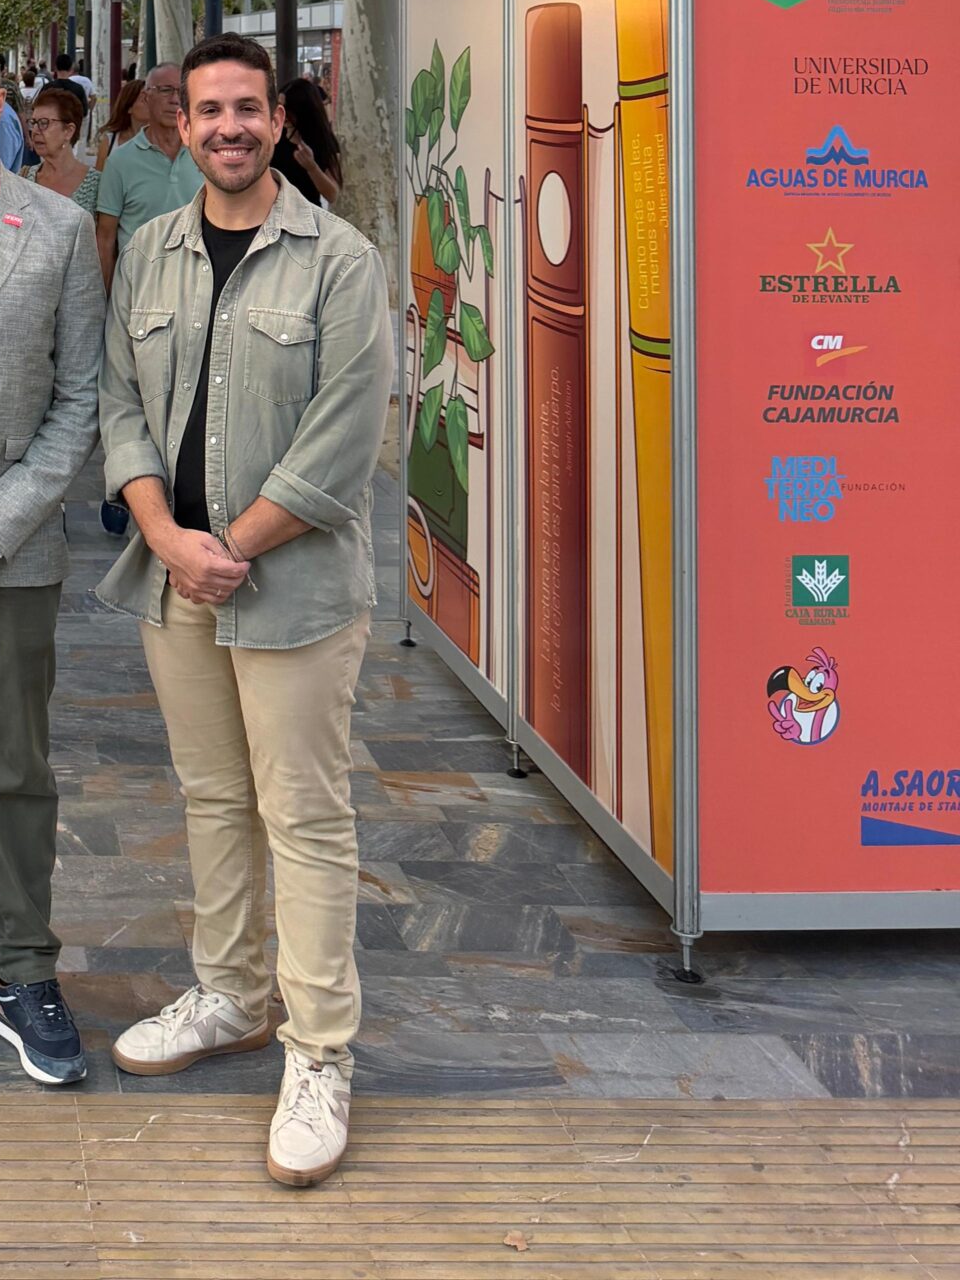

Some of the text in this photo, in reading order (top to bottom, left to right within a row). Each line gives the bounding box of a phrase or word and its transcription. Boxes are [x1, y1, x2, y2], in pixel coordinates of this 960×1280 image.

[794, 57, 929, 76] UNIVERSIDAD
[794, 77, 908, 96] DE MURCIA
[654, 133, 667, 185] Renard
[746, 168, 929, 189] AGUAS DE MURCIA
[658, 188, 669, 228] Jules
[629, 133, 650, 309] Cuanto más se lee.
[642, 146, 661, 294] menos se imita
[759, 275, 902, 294] ESTRELLA
[792, 294, 870, 304] DE LEVANTE
[811, 334, 843, 350] CM
[767, 381, 895, 402] FUNDACIÓN
[762, 406, 900, 424] CAJAMURCIA
[549, 440, 560, 459] el
[539, 469, 550, 488] la
[551, 463, 562, 511] para
[841, 482, 906, 492] FUNDACIÓN
[540, 490, 552, 537] para
[778, 500, 836, 522] NEO
[551, 513, 561, 537] es
[541, 540, 551, 564] es
[551, 541, 563, 627] ejercicio
[540, 568, 551, 636] lectura
[784, 608, 850, 618] CAJA RURAL
[550, 628, 561, 648] el
[540, 639, 551, 663] La
[551, 651, 564, 690] que
[549, 693, 561, 713] lo
[861, 801, 915, 812] MONTAJE
[919, 801, 934, 812] DE
